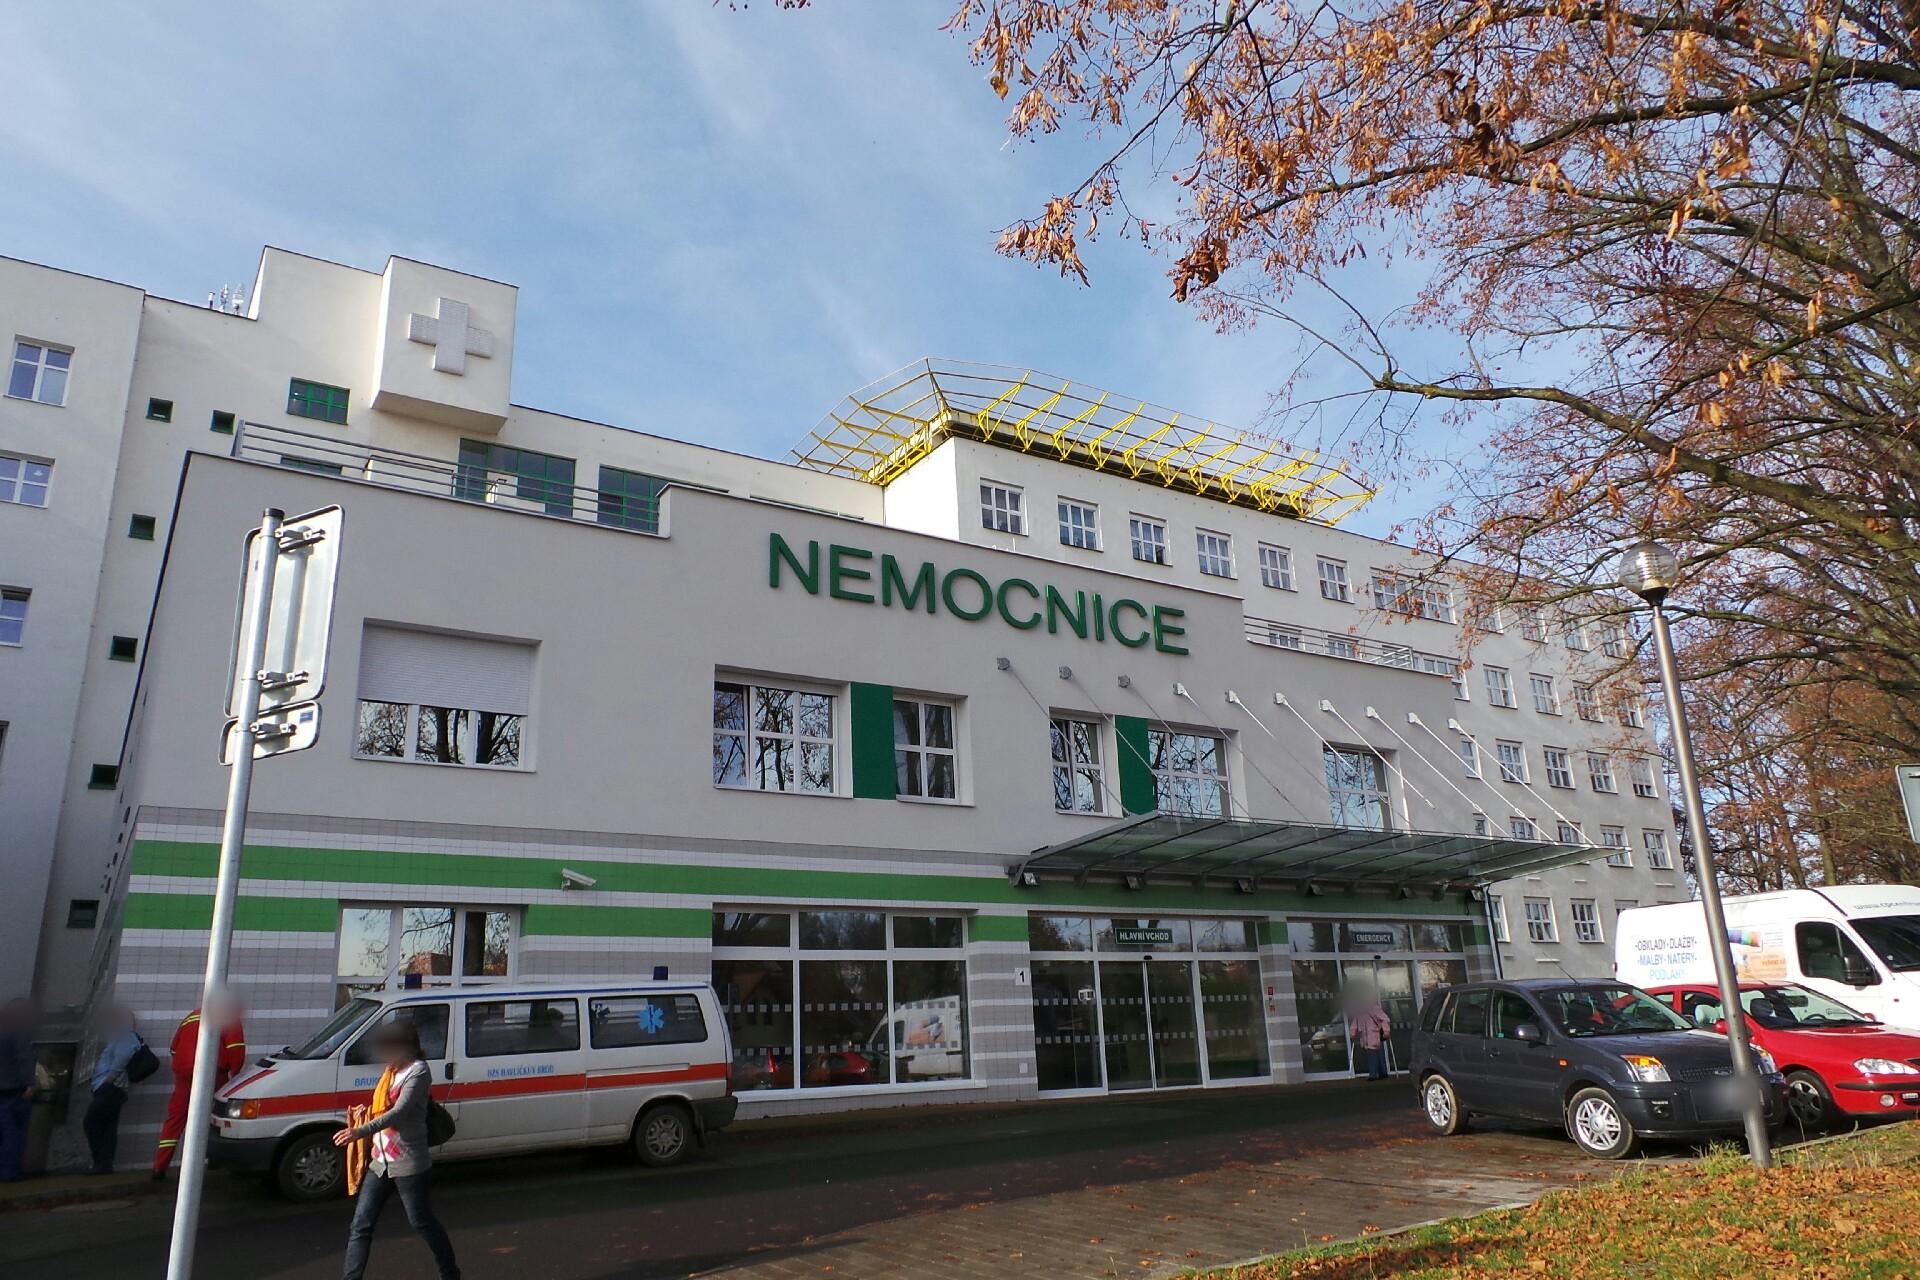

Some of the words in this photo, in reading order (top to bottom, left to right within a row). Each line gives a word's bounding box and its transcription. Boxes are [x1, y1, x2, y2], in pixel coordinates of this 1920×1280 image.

[769, 532, 1189, 655] NEMOCNICE
[1119, 930, 1145, 941] HLAVNÍ
[1145, 932, 1170, 941] VCHOD
[1355, 934, 1392, 943] EMERGENCY
[1019, 970, 1025, 983] 1
[354, 1077, 381, 1088] BAUK
